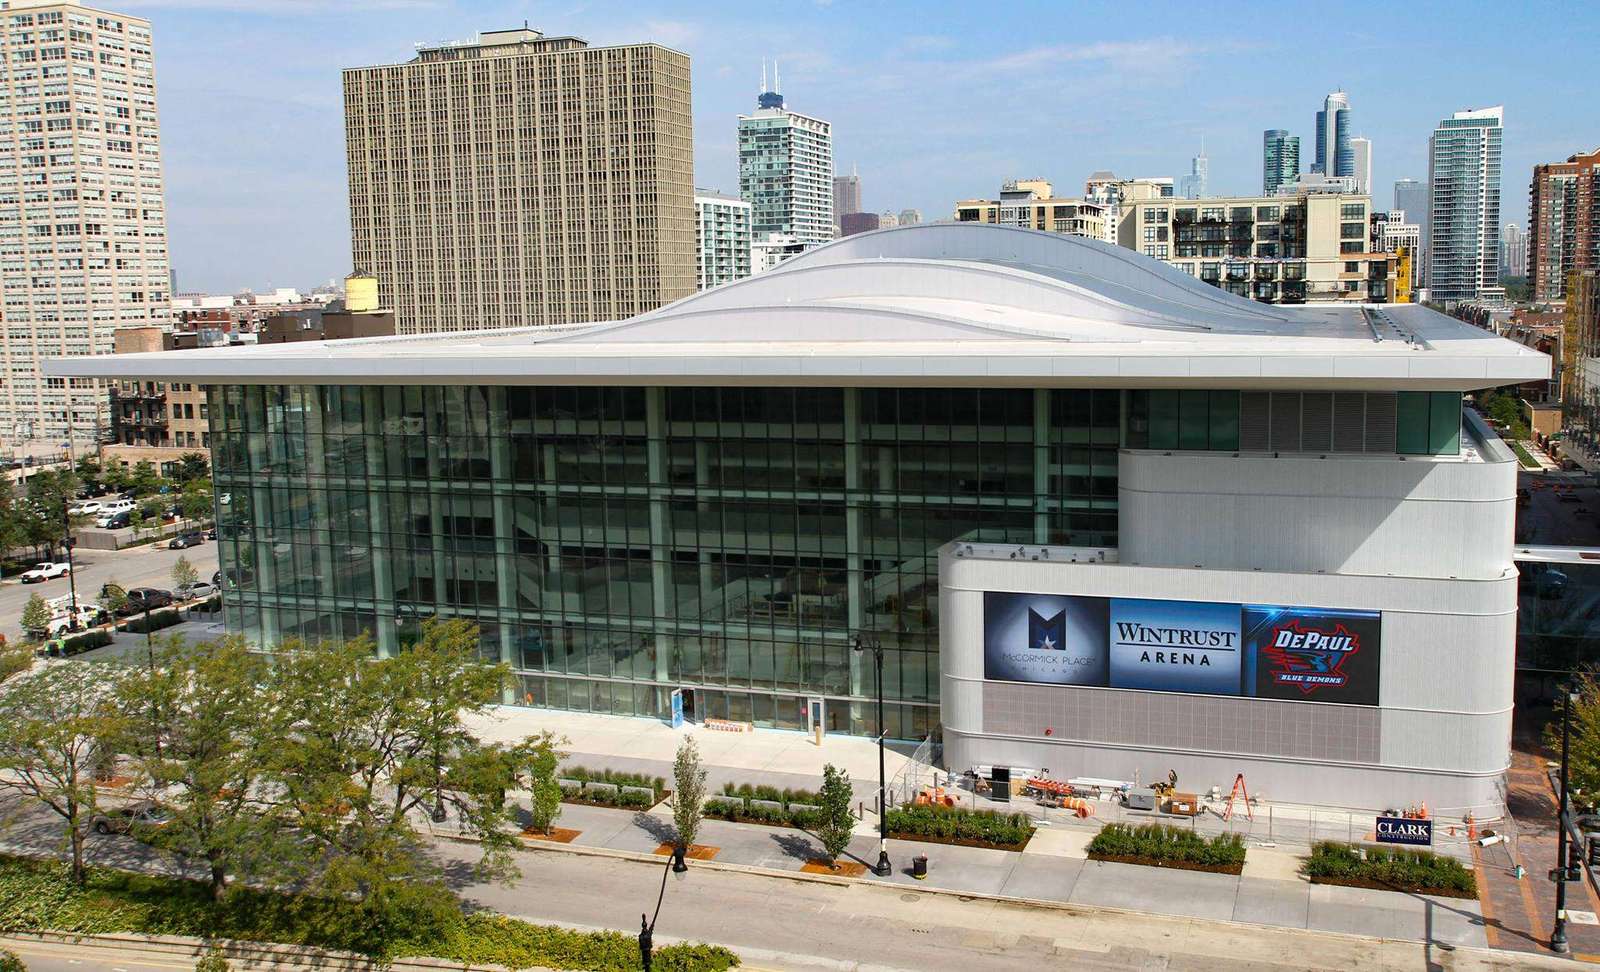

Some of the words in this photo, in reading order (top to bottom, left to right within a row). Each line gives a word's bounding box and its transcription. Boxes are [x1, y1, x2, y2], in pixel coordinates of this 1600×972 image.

[1116, 622, 1236, 647] WINTRUST
[1140, 651, 1210, 666] ARENA
[1281, 674, 1304, 682] BLUE
[1306, 674, 1342, 684] DEMONS
[1377, 822, 1429, 836] CLARK
